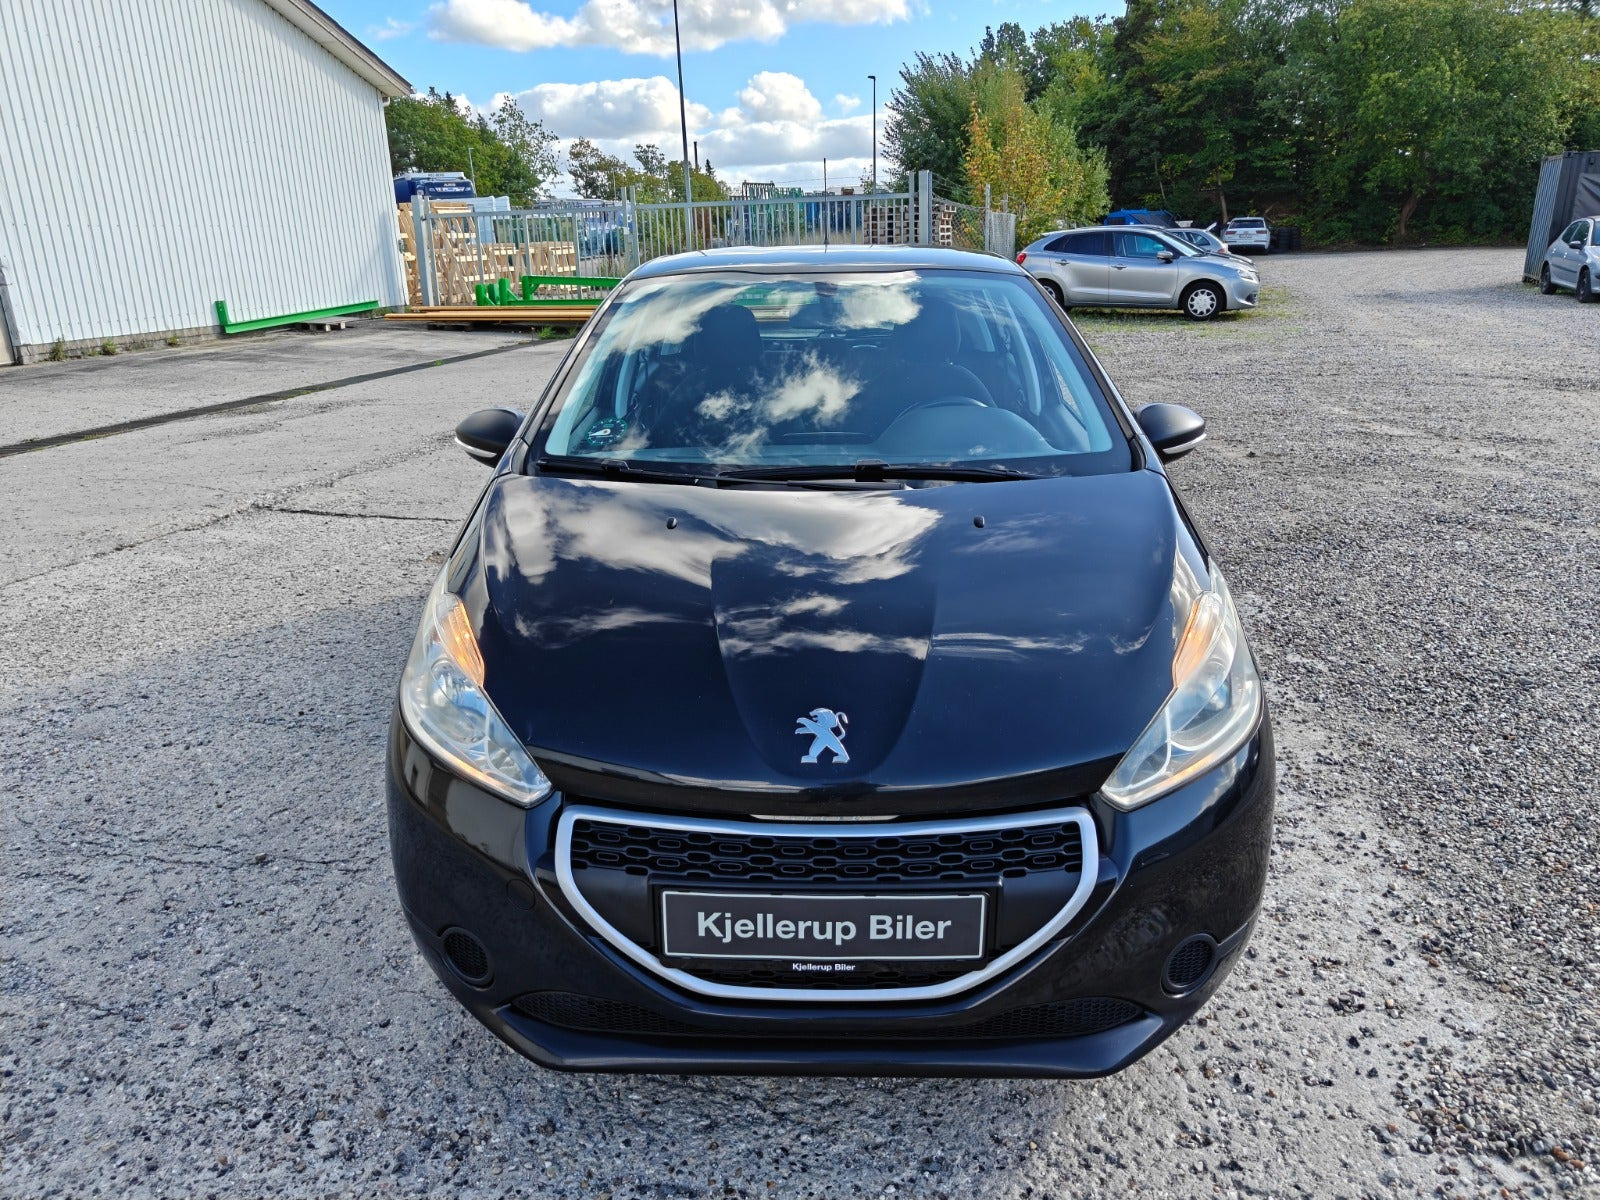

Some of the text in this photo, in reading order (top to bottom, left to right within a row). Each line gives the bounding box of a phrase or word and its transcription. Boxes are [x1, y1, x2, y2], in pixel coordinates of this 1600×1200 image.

[697, 911, 952, 946] Kjellerup Biler
[792, 962, 856, 972] Kjellerup Biler
